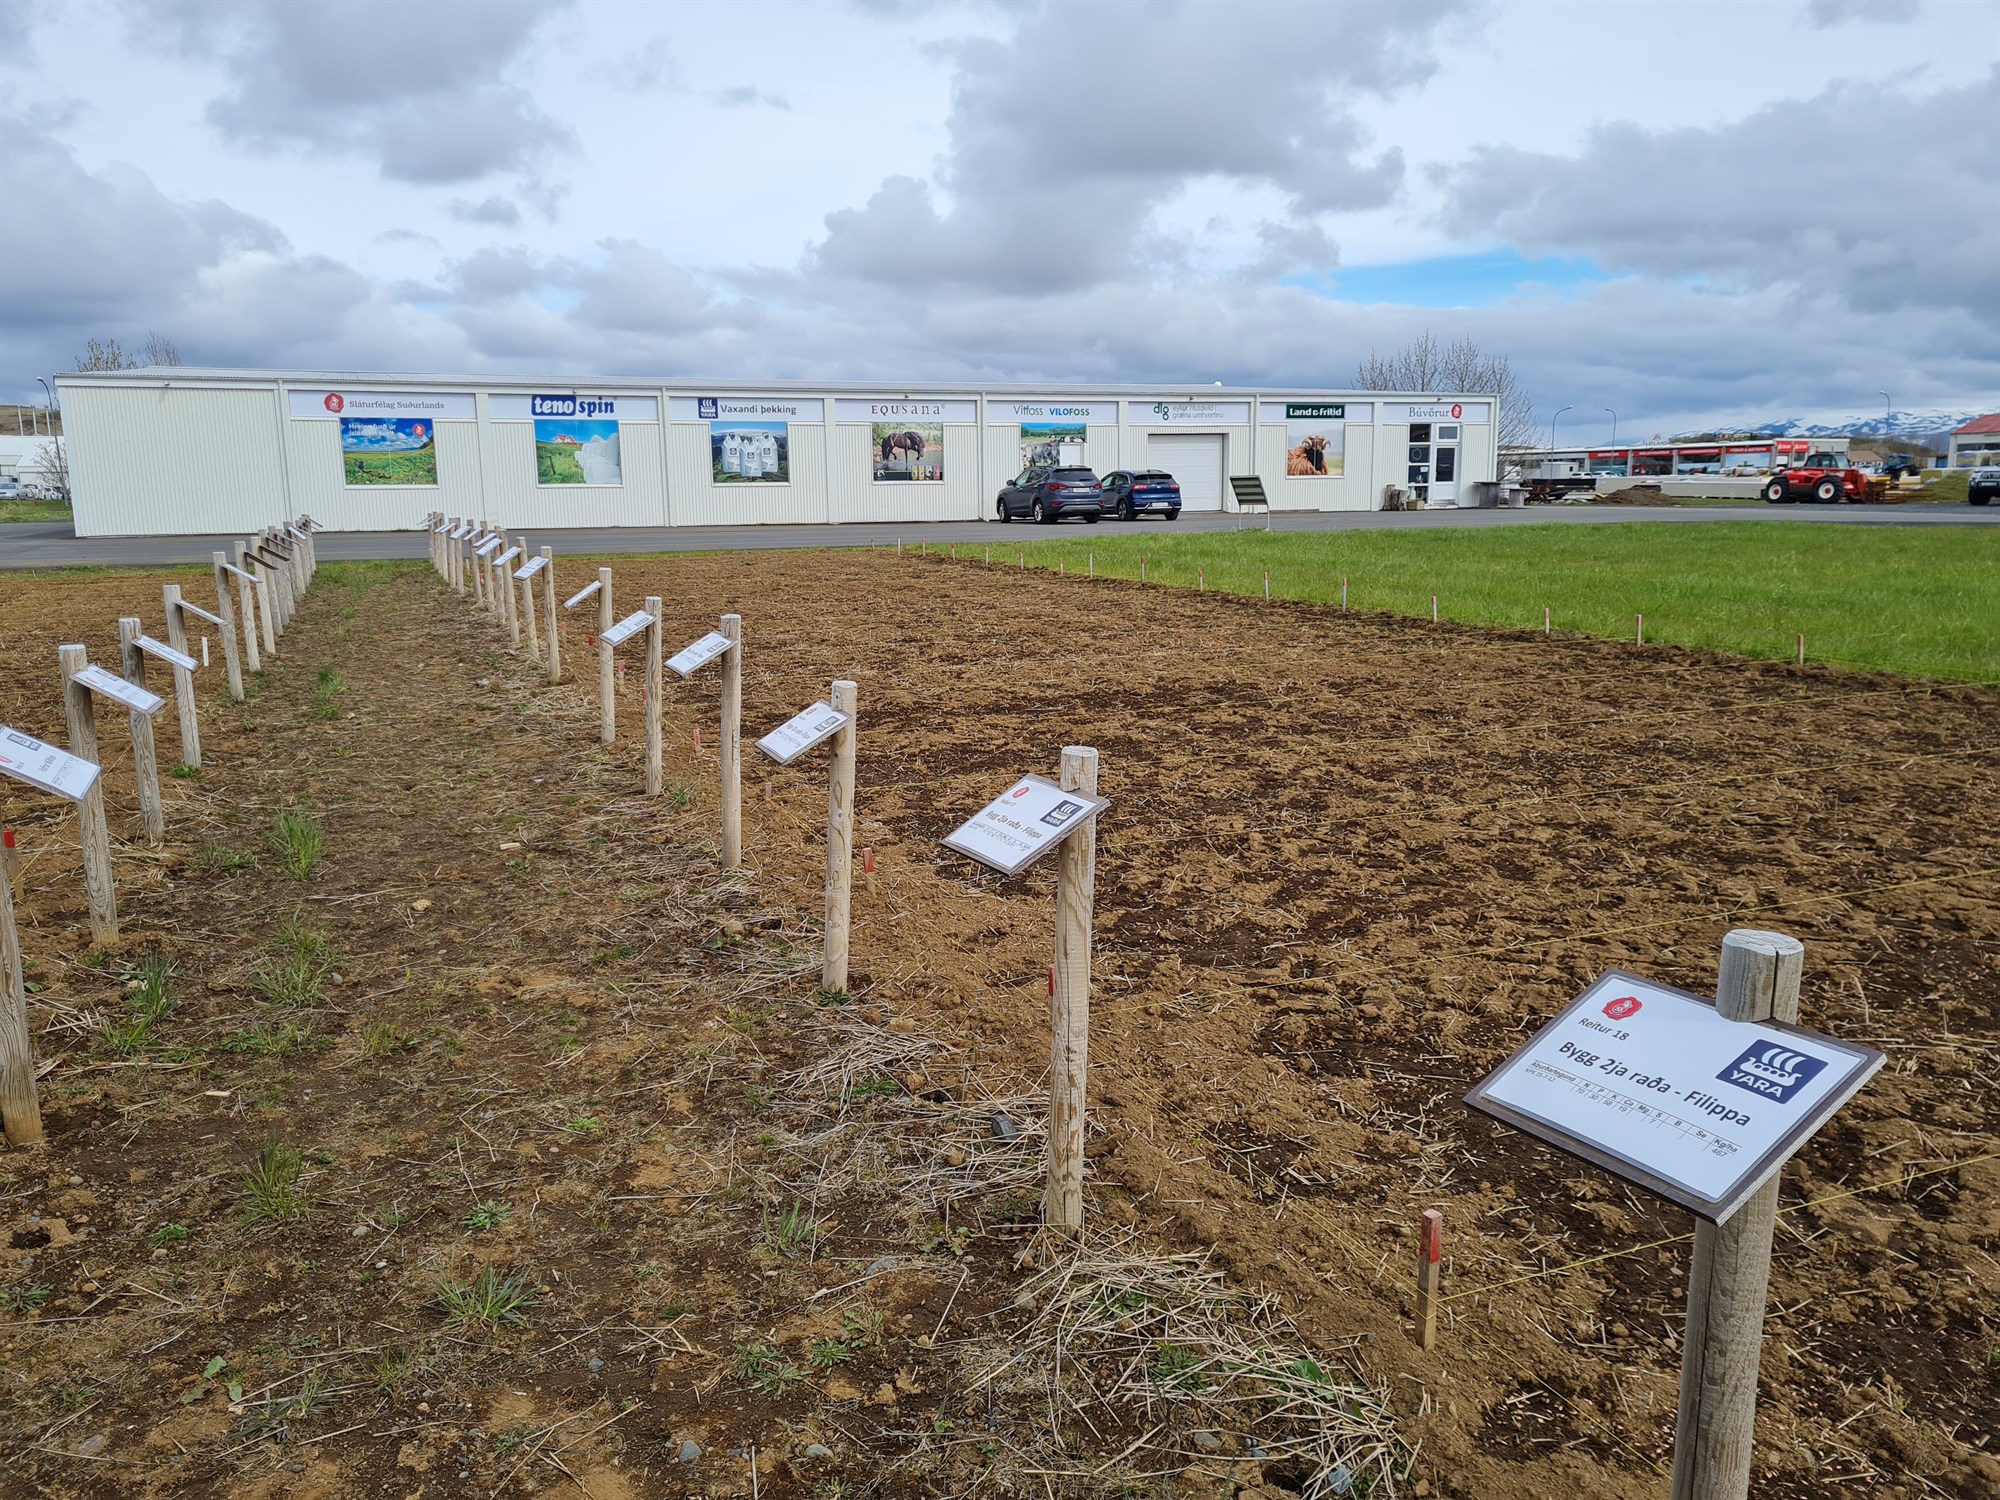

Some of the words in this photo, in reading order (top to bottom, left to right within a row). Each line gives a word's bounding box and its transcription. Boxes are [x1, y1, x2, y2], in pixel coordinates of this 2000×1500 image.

[349, 400, 395, 410] Sláturfélag
[397, 401, 445, 410] Suðurlands
[534, 396, 574, 414] teno
[578, 396, 615, 417] spin
[720, 404, 758, 413] Vaxandi
[760, 404, 797, 415] þekking
[1049, 407, 1090, 416] VILOFOSS
[1153, 402, 1169, 420] dlg
[1409, 405, 1449, 418] Búvörur
[1578, 1017, 1613, 1034] Reitur
[1612, 1030, 1630, 1041] 18
[1559, 1041, 1601, 1067] Bygg
[1599, 1058, 1628, 1076] 2ja
[1629, 1072, 1671, 1094] raða
[1683, 1090, 1751, 1127] Filippa
[1730, 1070, 1783, 1097] YARA
[1603, 1099, 1613, 1107] 58
[1618, 1105, 1628, 1113] 19
[1711, 1147, 1728, 1158] 467
[1638, 1105, 1650, 1114] Mg
[1696, 1130, 1707, 1139] Se
[1713, 1138, 1738, 1153] Kg/ha
